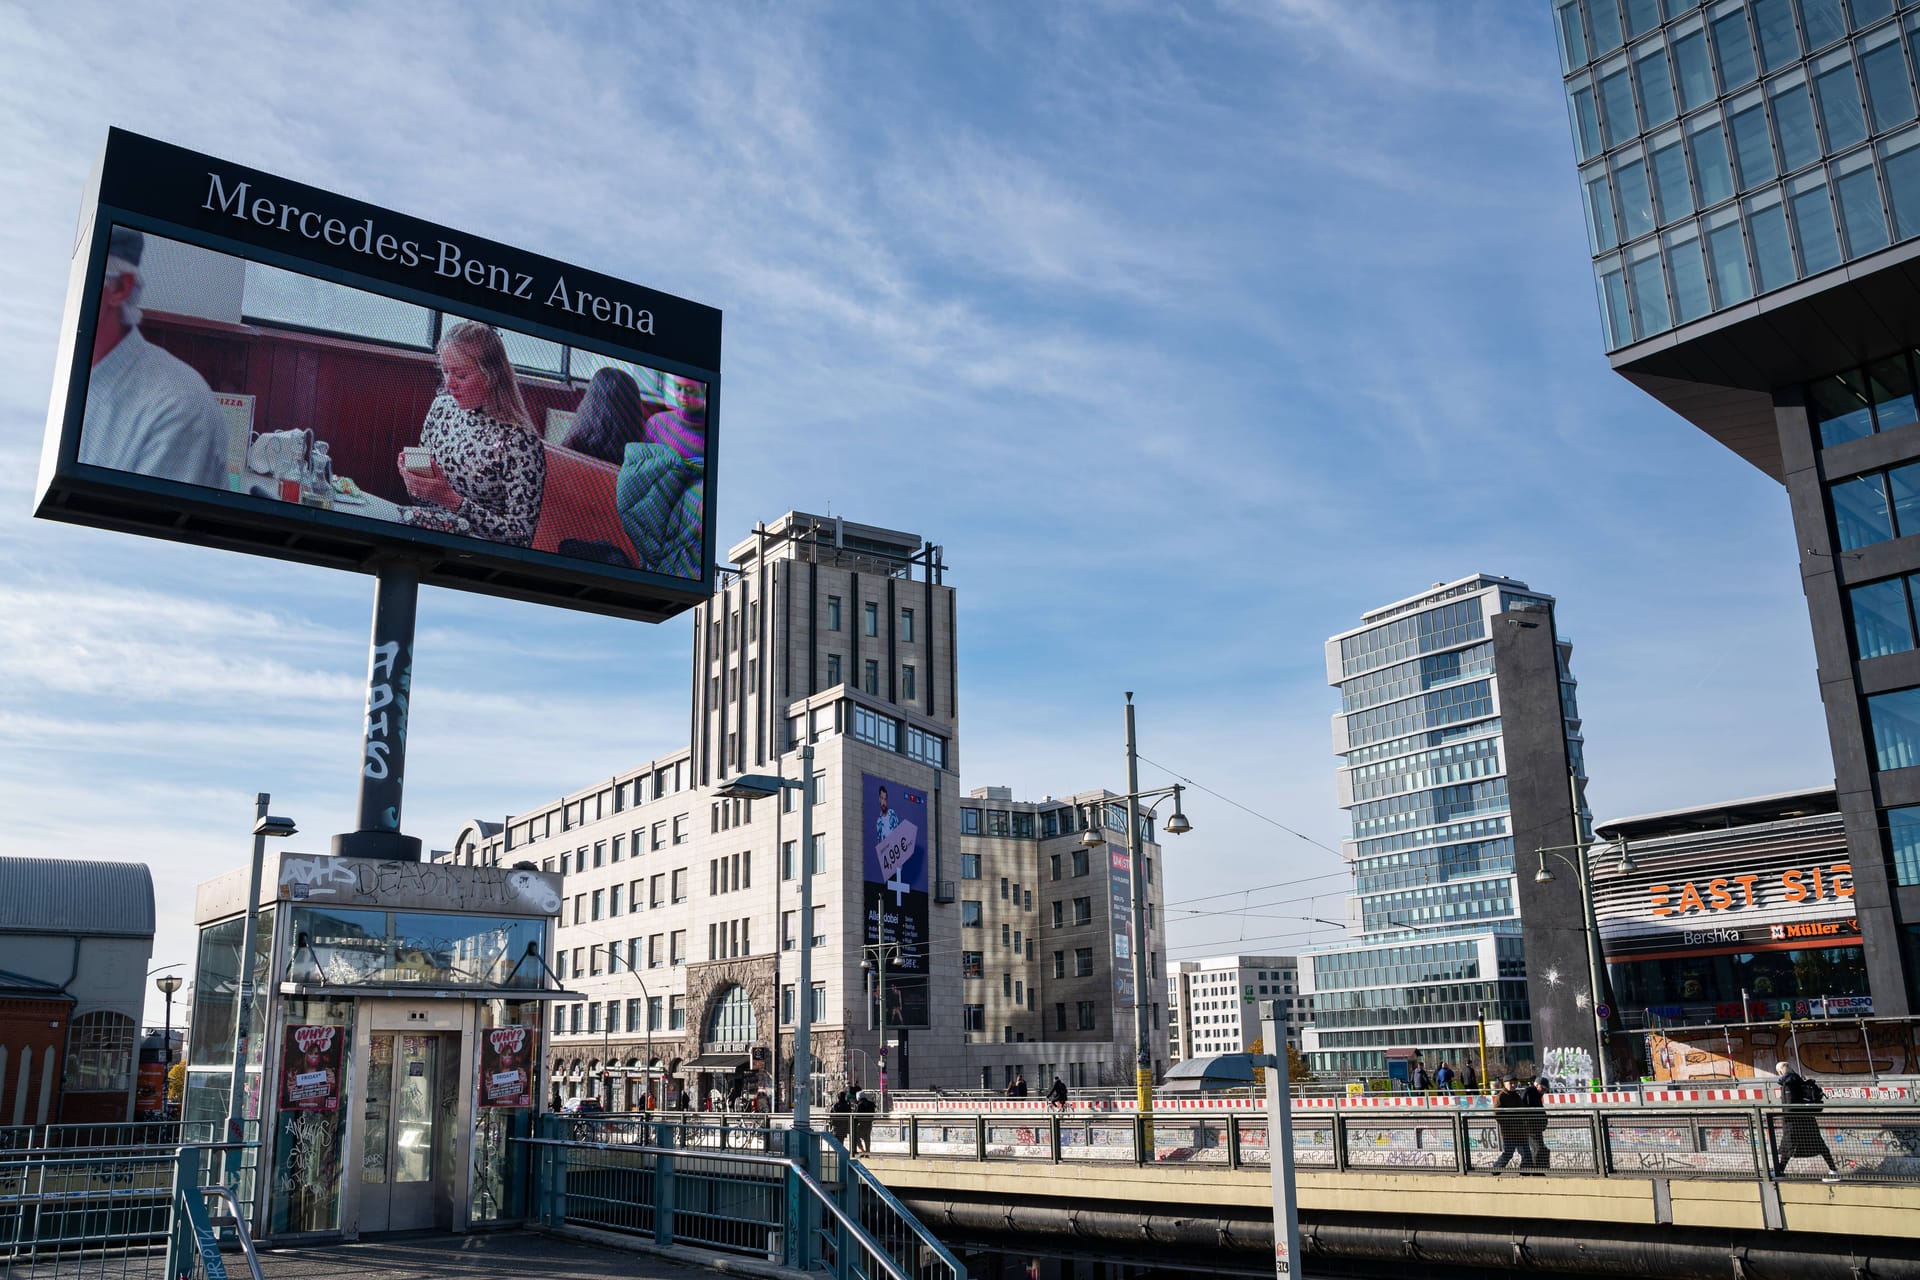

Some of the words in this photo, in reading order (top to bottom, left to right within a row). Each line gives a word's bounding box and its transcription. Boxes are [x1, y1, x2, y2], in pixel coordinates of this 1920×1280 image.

[202, 172, 534, 300] Mercedes-Benz
[543, 275, 656, 336] Arena
[1649, 874, 1759, 915] EAST
[1683, 927, 1739, 946] Bershka
[1786, 922, 1840, 938] Müller
[297, 1027, 332, 1041] WHY?
[492, 1030, 523, 1043] WHY?
